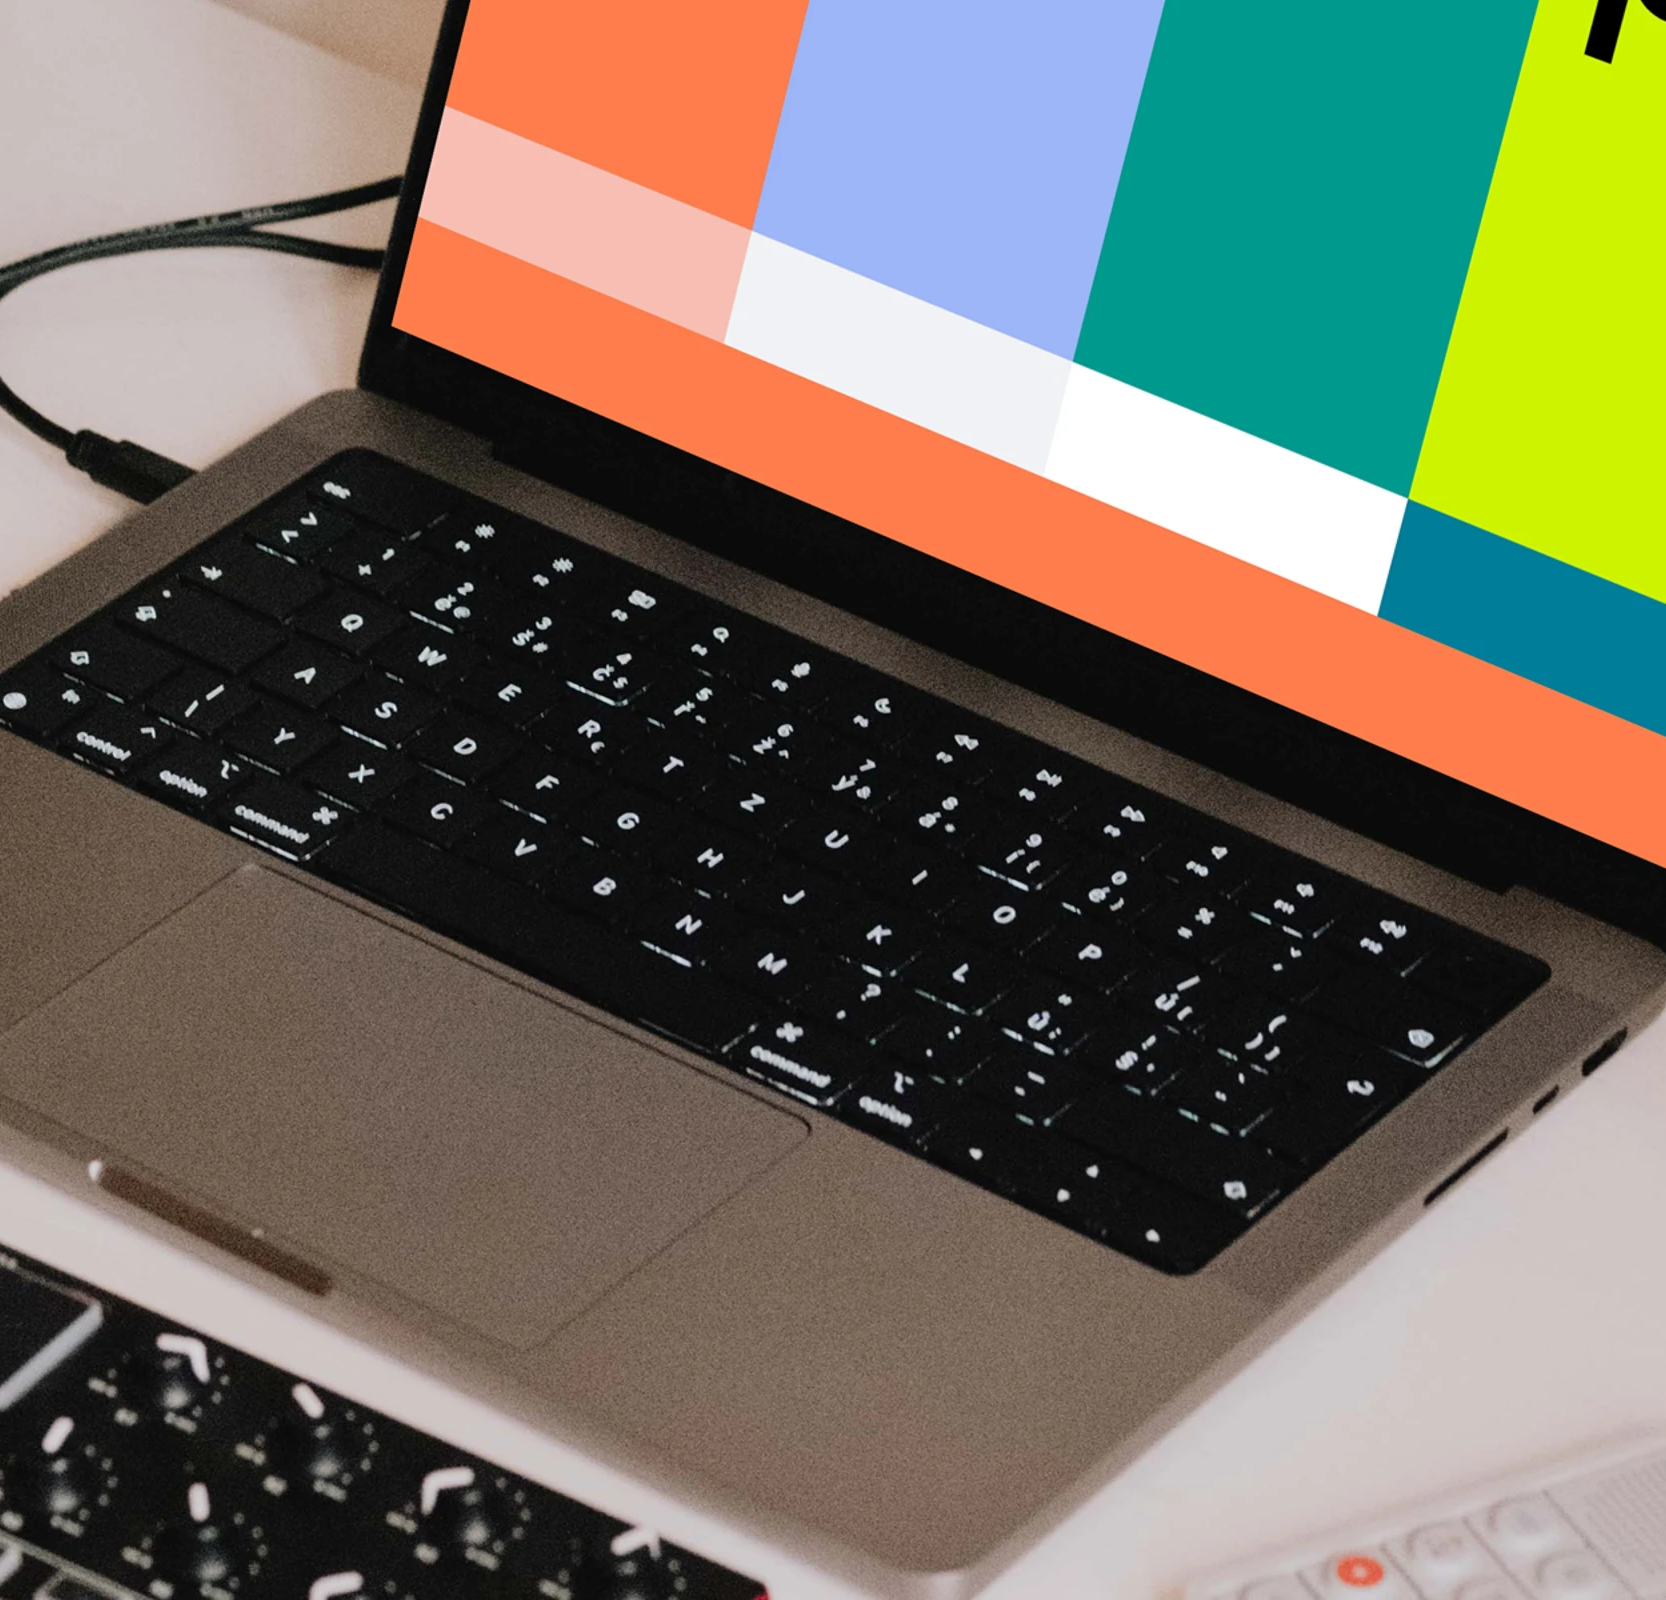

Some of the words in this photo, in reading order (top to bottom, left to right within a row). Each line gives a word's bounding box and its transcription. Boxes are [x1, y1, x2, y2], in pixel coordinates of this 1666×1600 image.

[340, 613, 364, 633] Q
[417, 645, 448, 667] W
[293, 667, 317, 685] A
[497, 683, 522, 702] E
[374, 701, 398, 719] S
[273, 727, 296, 745] Y
[577, 719, 601, 739] R
[76, 731, 132, 762] control
[453, 737, 477, 756] D
[348, 763, 375, 784] X
[662, 755, 685, 773] T
[159, 769, 208, 798] option
[535, 774, 560, 790] F
[430, 802, 454, 820] C
[739, 792, 766, 813] Z
[234, 804, 310, 844] command
[616, 812, 640, 830] G
[514, 838, 538, 857] V
[824, 829, 850, 849] U
[696, 847, 724, 868] H
[592, 876, 617, 896] B
[782, 889, 806, 905] J
[675, 914, 703, 935] N
[866, 924, 892, 945] K
[1078, 943, 1103, 960] P
[757, 952, 788, 975] M
[952, 963, 969, 983] L
